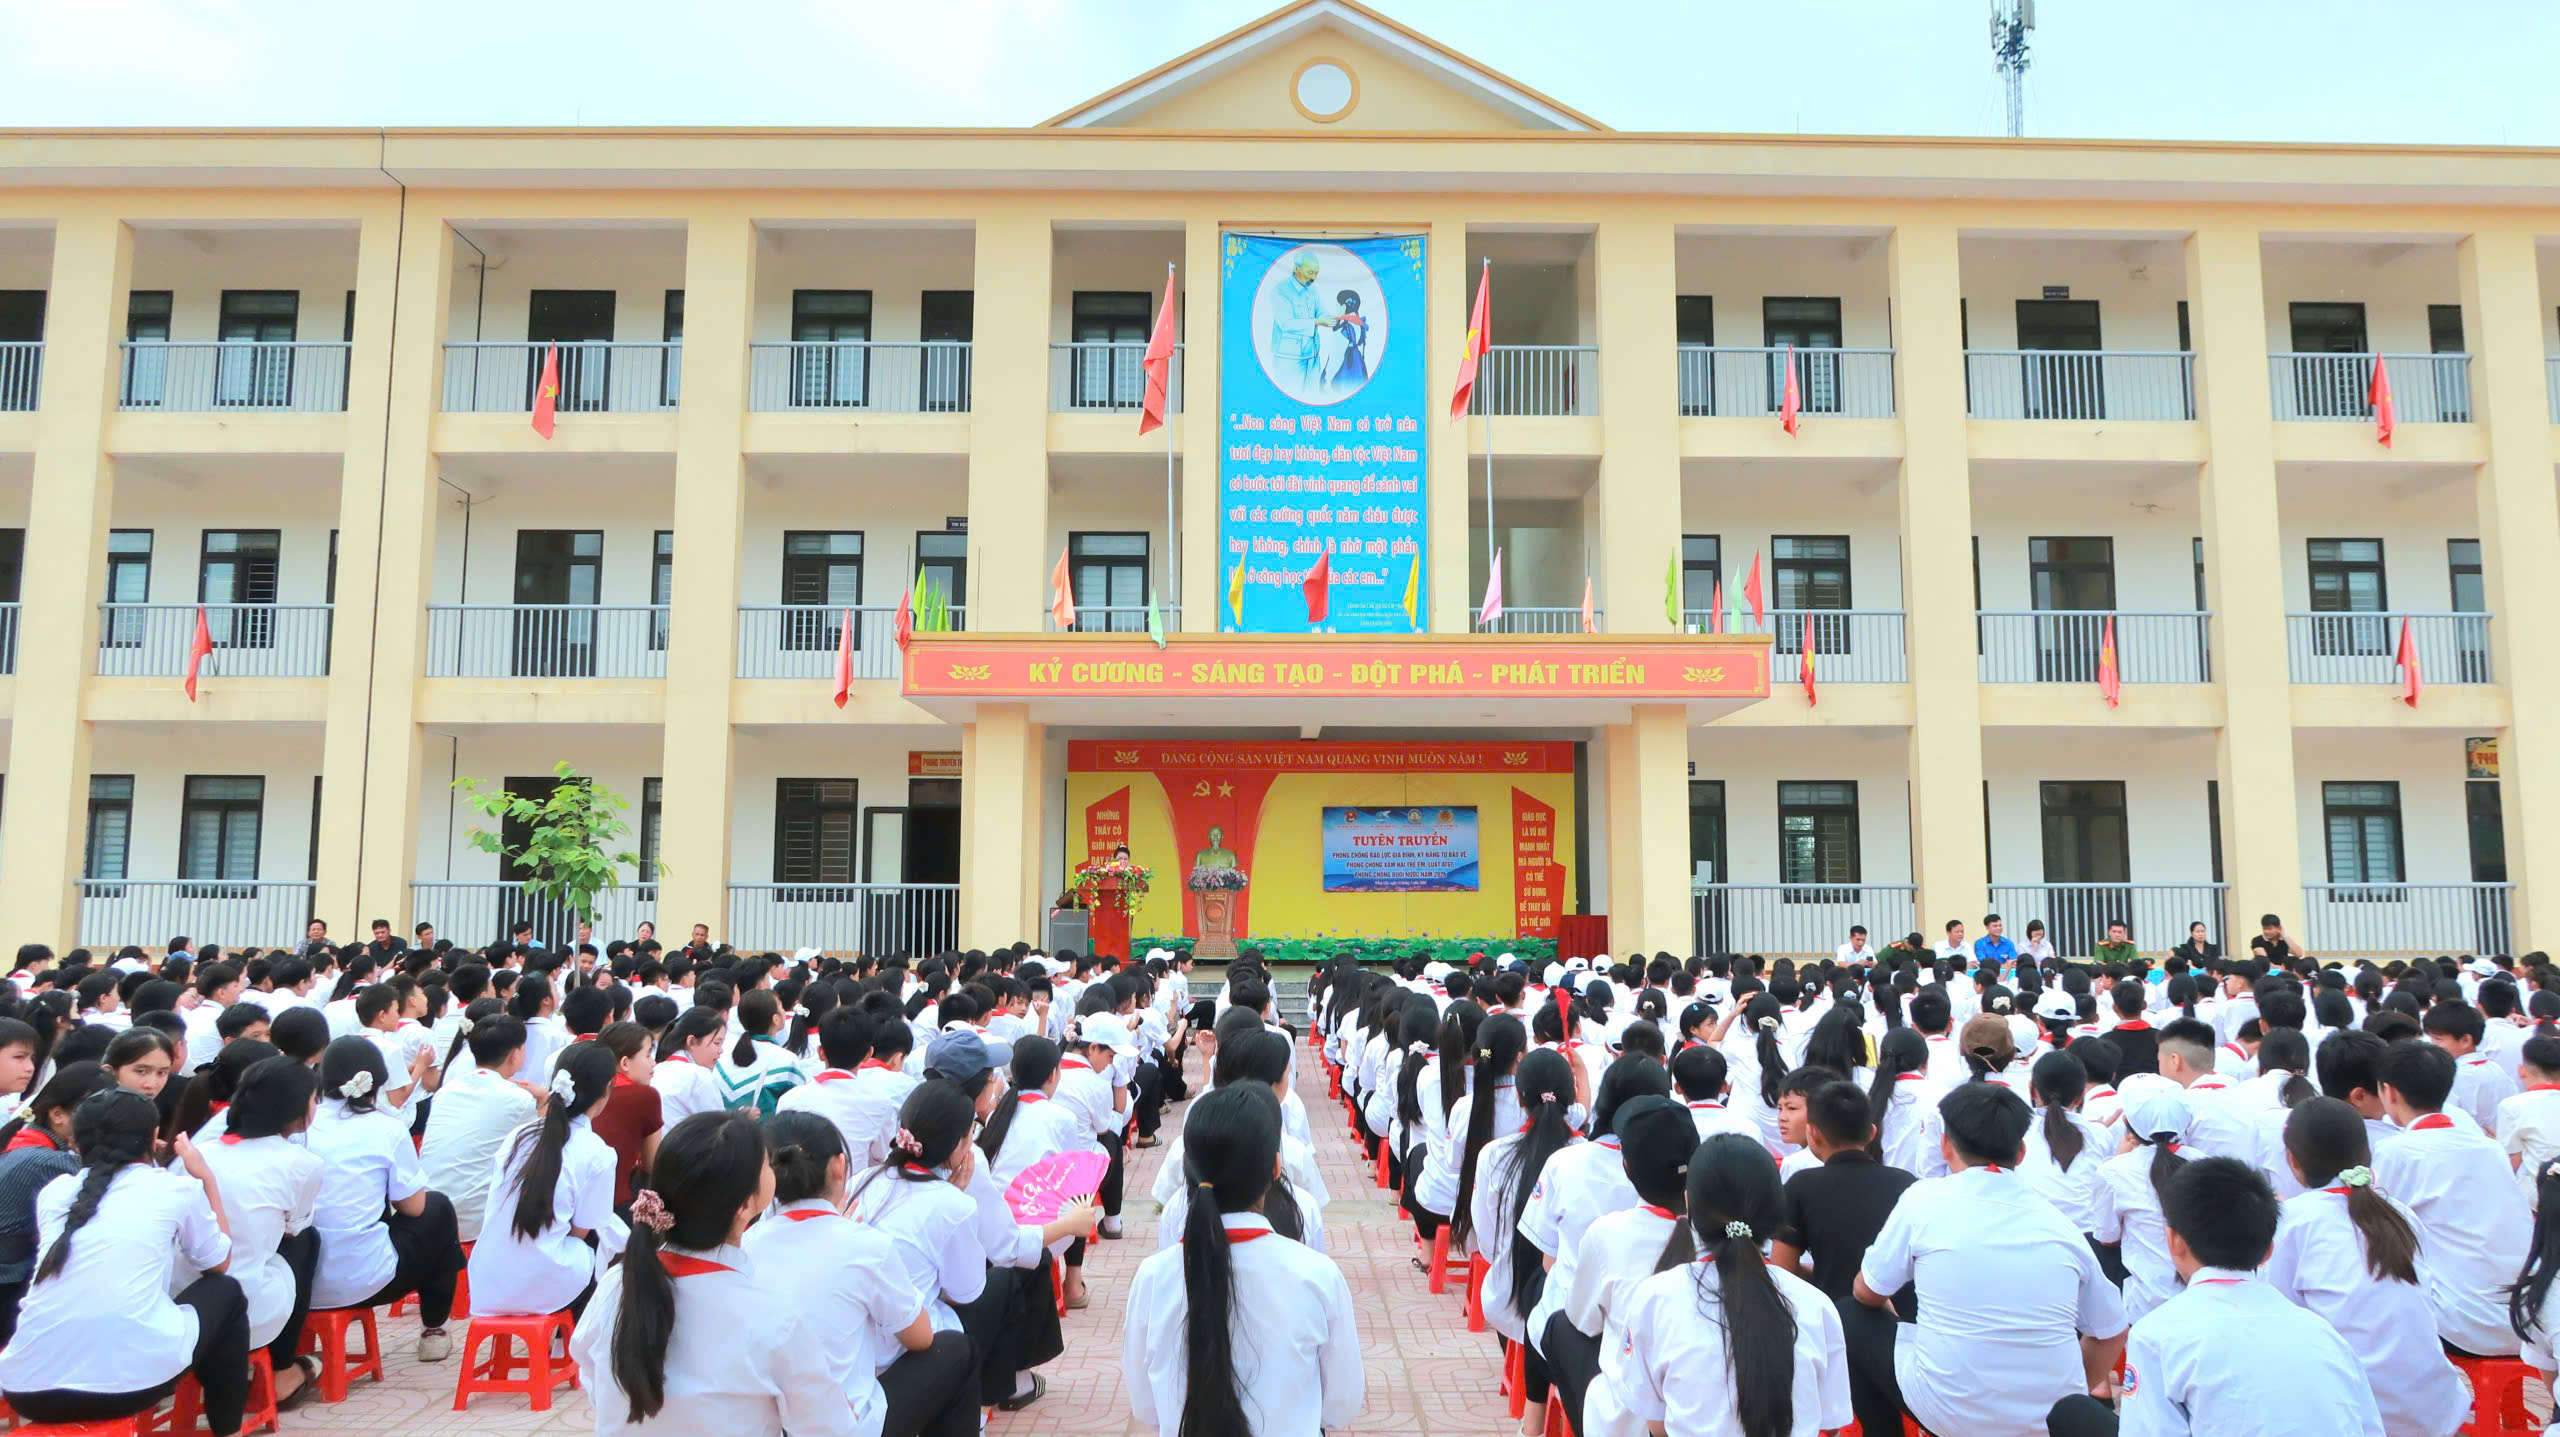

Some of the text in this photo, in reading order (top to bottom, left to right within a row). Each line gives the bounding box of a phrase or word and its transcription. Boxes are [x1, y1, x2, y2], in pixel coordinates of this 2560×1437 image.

[1270, 415, 1295, 434] sông
[1300, 415, 1322, 434] Việt
[1328, 416, 1352, 431] Nam
[1356, 415, 1370, 431] có
[1376, 415, 1392, 431] trở
[1397, 416, 1417, 431] nên
[1230, 444, 1417, 466] tươi đẹp hay không, dân tộc Việt Nam
[1230, 473, 1417, 496] có bước tới đài vinh quang để sánh vai
[1230, 504, 1418, 527] với các cường quốc năm châu được
[1253, 536, 1288, 556] không,
[1293, 536, 1321, 553] chính
[1340, 536, 1361, 553] nhờ
[1366, 538, 1387, 557] một
[1392, 536, 1418, 557] phần
[1256, 567, 1281, 588] công
[1283, 567, 1302, 588] học
[1342, 567, 1360, 584] các
[1030, 657, 1063, 683] KỶ
[1072, 661, 1163, 683] CƯƠNG
[1192, 660, 1265, 683] SÁNG
[1274, 663, 1323, 687] TẠO
[1351, 660, 1402, 688] ĐỘT
[1411, 660, 1464, 683] PHÁ
[1492, 660, 1560, 683] PHÁT
[1568, 657, 1645, 683] TRIỂN
[1199, 750, 1234, 766] CỘNG
[1265, 751, 1293, 766] VIỆT
[1297, 753, 1324, 764] NAM
[1327, 753, 1370, 766] QUANG
[1373, 753, 1404, 764] VINH
[1408, 751, 1446, 764] MUÔN
[1448, 752, 1475, 764] NĂM
[1353, 832, 1448, 846] TUYÊN TRUYỀN
